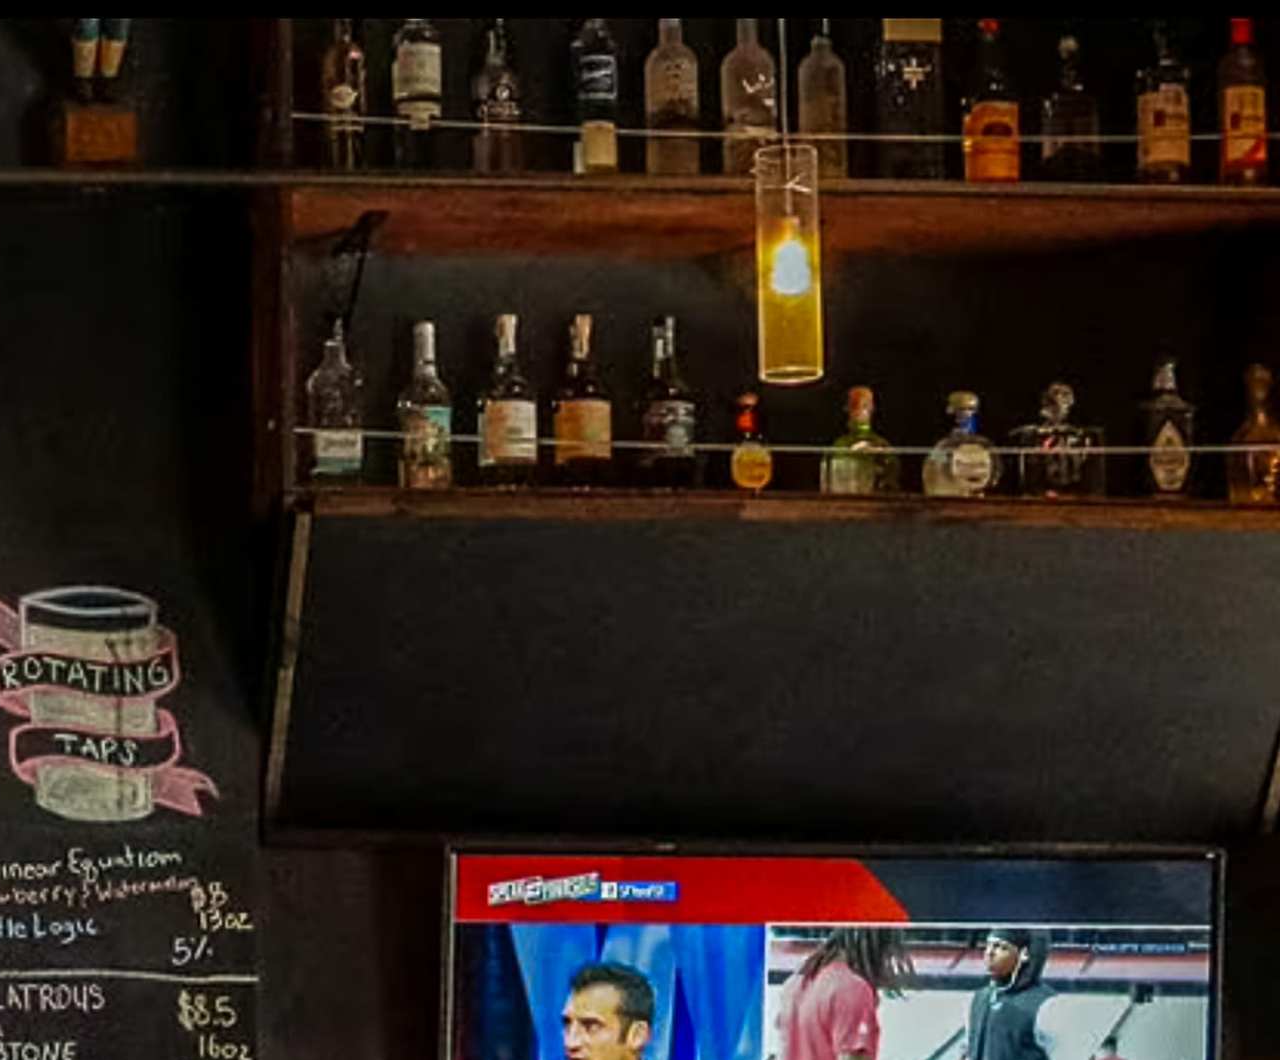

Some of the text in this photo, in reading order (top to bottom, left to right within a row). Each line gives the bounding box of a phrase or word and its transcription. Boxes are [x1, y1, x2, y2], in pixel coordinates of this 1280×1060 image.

[2, 656, 170, 694] ROTATING
[54, 733, 139, 766] TAPS
[32, 912, 99, 944] Logic
